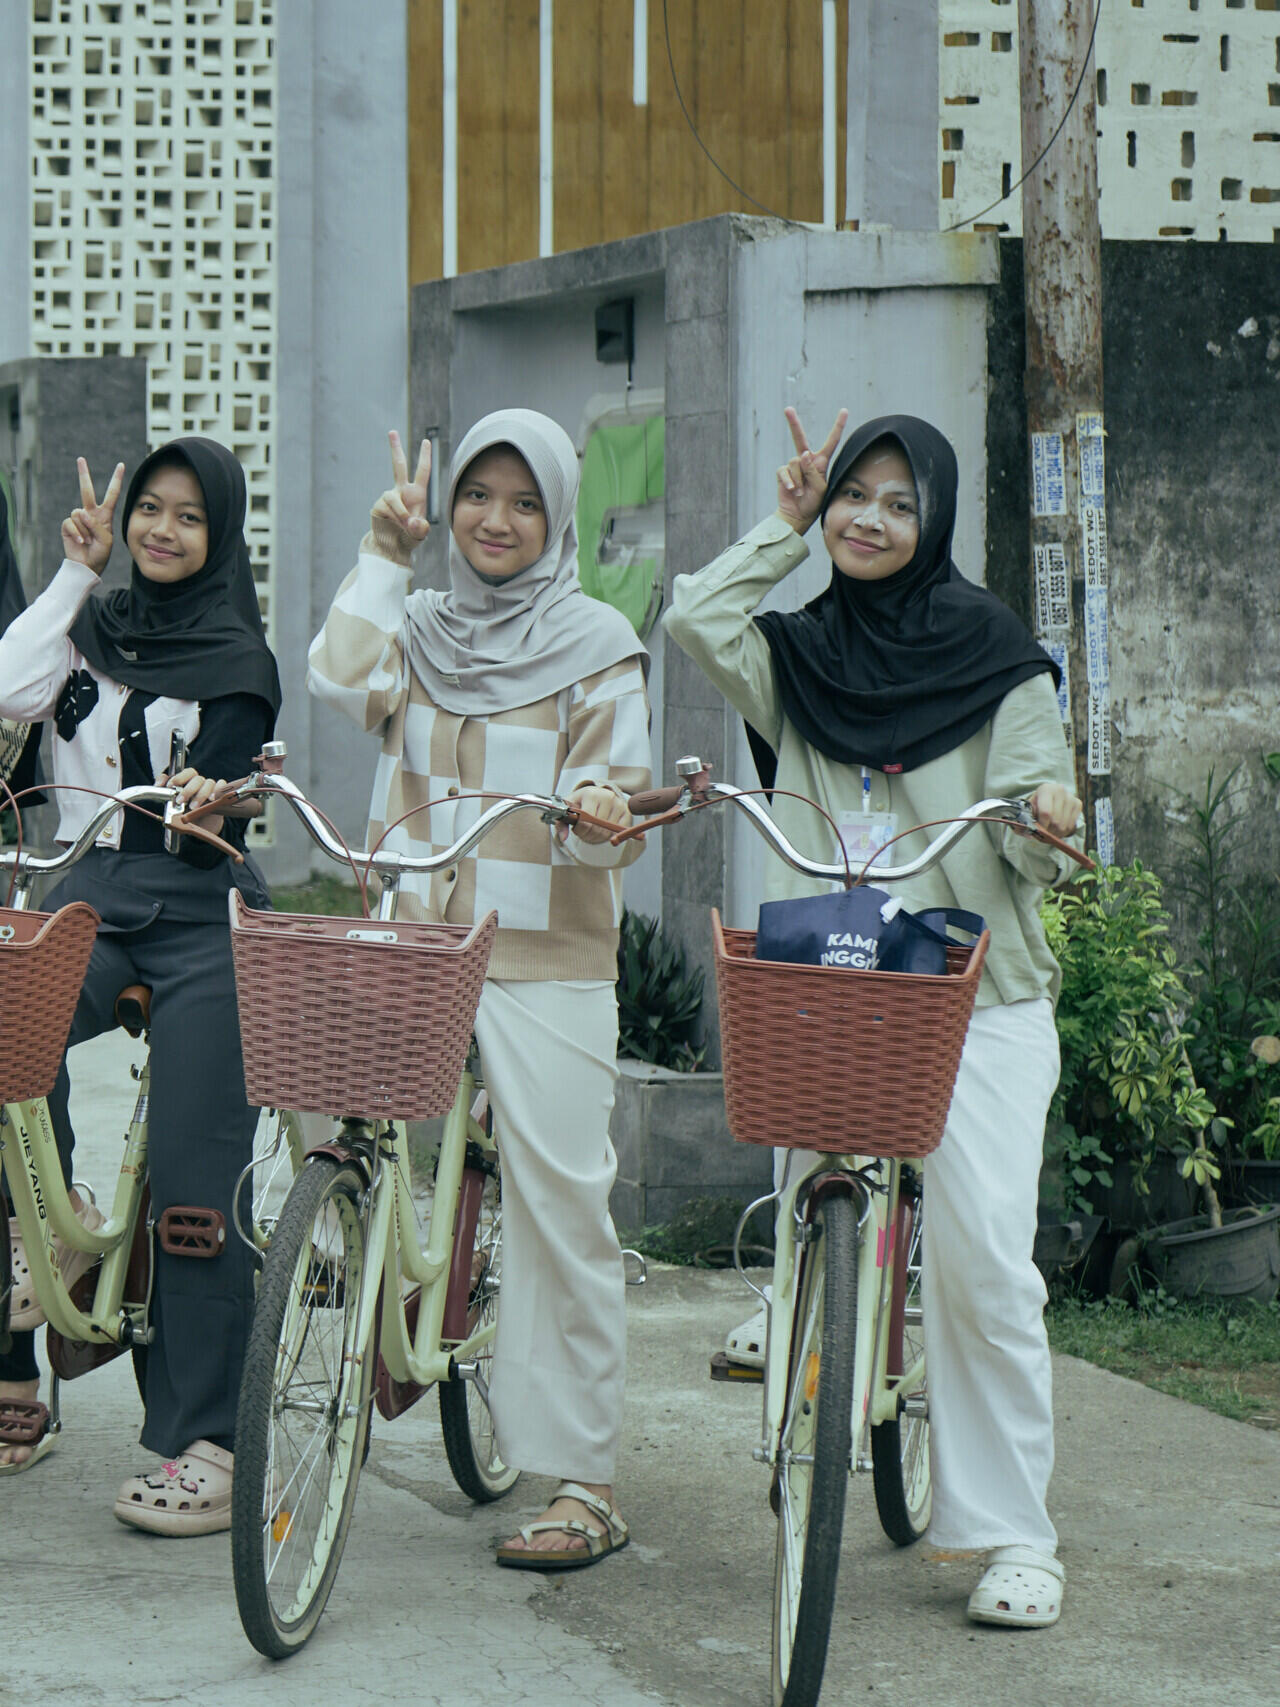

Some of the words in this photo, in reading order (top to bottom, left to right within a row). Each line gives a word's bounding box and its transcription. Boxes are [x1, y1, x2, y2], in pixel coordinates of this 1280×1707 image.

[1033, 436, 1041, 460] WC
[1035, 464, 1043, 513] SEDOT
[1086, 509, 1094, 533] WC
[1037, 549, 1044, 573] WC
[1087, 537, 1096, 586] SEDOT
[1039, 577, 1048, 626] SEDOT
[1089, 629, 1098, 679] SEDOT
[1092, 720, 1100, 769] SEDOT
[19, 1126, 47, 1220] JIEYANG
